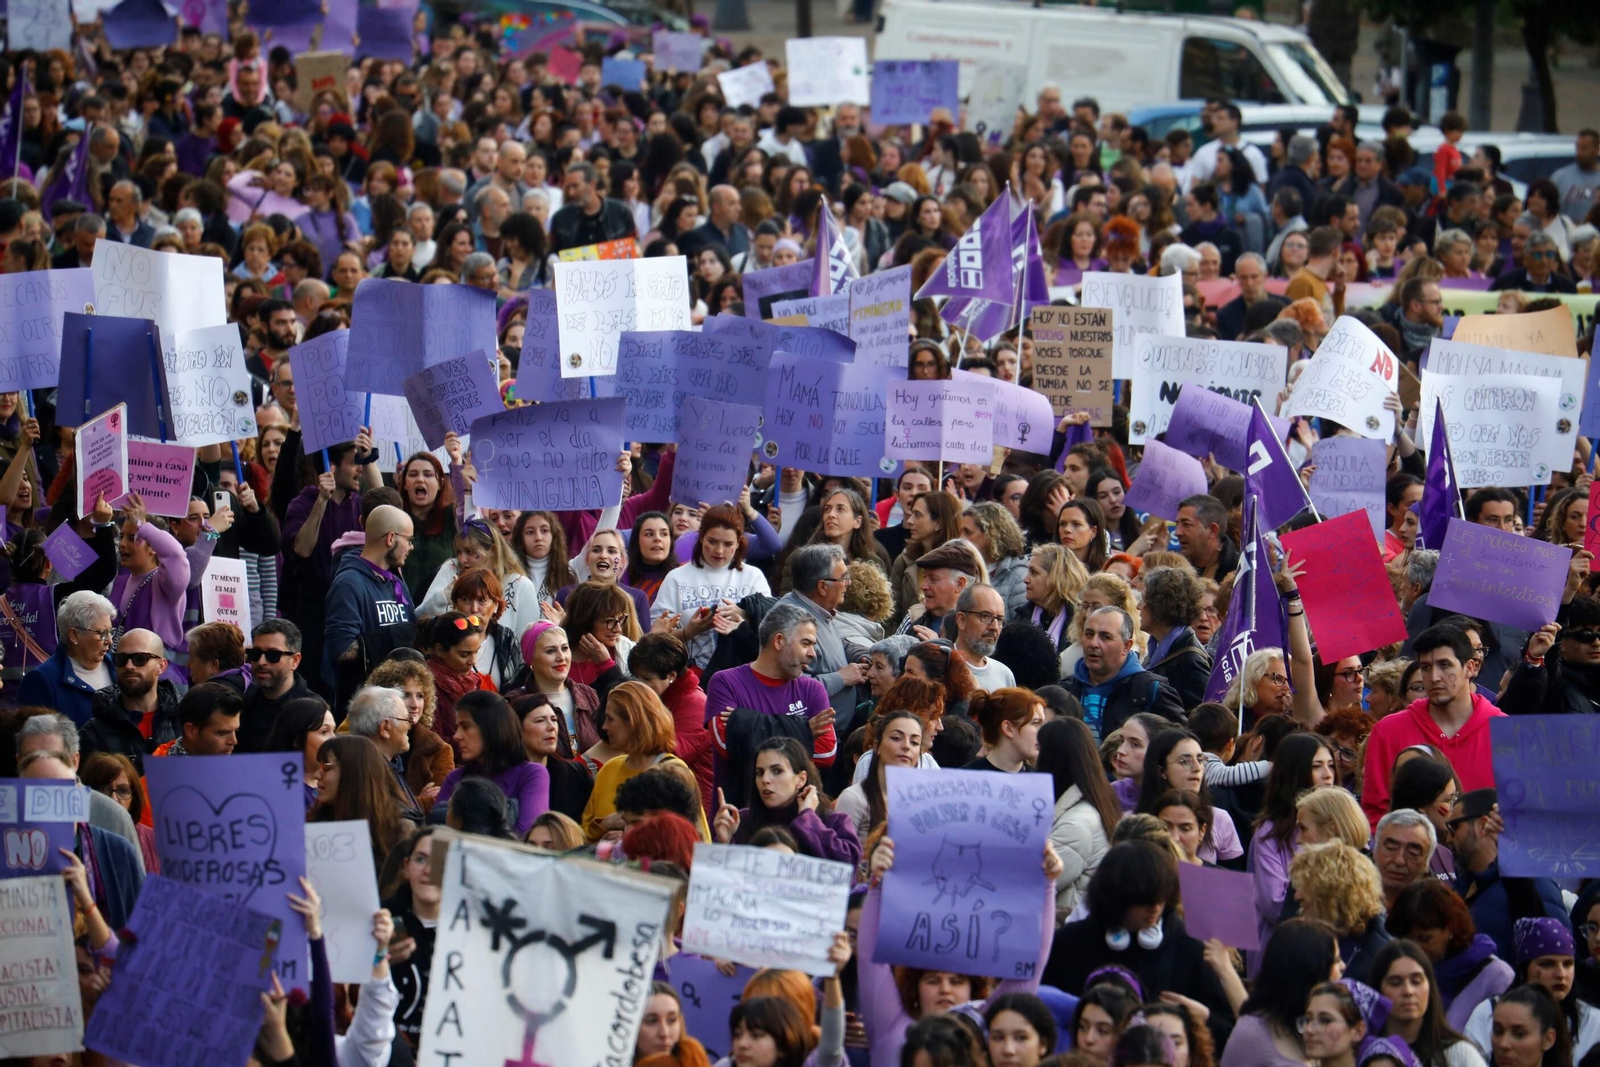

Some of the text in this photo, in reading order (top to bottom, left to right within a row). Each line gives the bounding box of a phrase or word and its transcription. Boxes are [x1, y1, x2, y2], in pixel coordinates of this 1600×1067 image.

[102, 245, 151, 285] NO
[97, 283, 162, 318] FUE
[1033, 310, 1107, 326] HOY NO ESTÁN
[1034, 329, 1113, 342] TODAS NUESTRAS
[1526, 329, 1545, 345] YA
[588, 336, 612, 369] NO
[1035, 346, 1062, 358] VOCES
[1139, 340, 1194, 374] QUIEN
[439, 357, 468, 378] VES
[1036, 364, 1092, 376] DESDE LA
[1369, 346, 1394, 382] NO
[195, 375, 231, 407] NO
[777, 364, 824, 408] MAMÁ
[1036, 377, 1110, 391] TUMBA NO SE
[445, 391, 482, 416] PARTE
[895, 389, 919, 412] Hoy
[977, 396, 988, 407] en
[313, 405, 363, 449] POR
[552, 408, 570, 423] va
[589, 408, 601, 424] a
[774, 406, 796, 428] HOY
[808, 414, 824, 430] NO
[891, 415, 975, 431] las calles pero
[496, 431, 525, 448] ser
[539, 426, 554, 447] el
[945, 441, 966, 452] cada
[498, 447, 609, 478] que no falte
[794, 441, 862, 466] POR LA CALLE
[136, 473, 153, 482] ser
[165, 462, 188, 472] casa
[1333, 472, 1350, 487] NO
[1353, 473, 1375, 488] VOY
[129, 487, 171, 499] valiente
[495, 475, 605, 509] NINGUNA
[1452, 525, 1475, 543] Les
[1481, 534, 1529, 553] molesta
[1460, 546, 1472, 558] el
[1473, 560, 1490, 572] que
[211, 573, 241, 583] TU MENTE
[216, 608, 229, 616] QUE
[376, 603, 409, 624] HOPE
[998, 784, 1026, 810] DE
[908, 801, 1030, 844] VOLVER A CASA
[164, 813, 272, 855] LIBRES
[4, 828, 49, 870] NO
[775, 855, 852, 886] MOLESTA
[703, 906, 722, 922] LO
[904, 898, 1013, 963] ASÍ?
[1013, 961, 1036, 979] 8M
